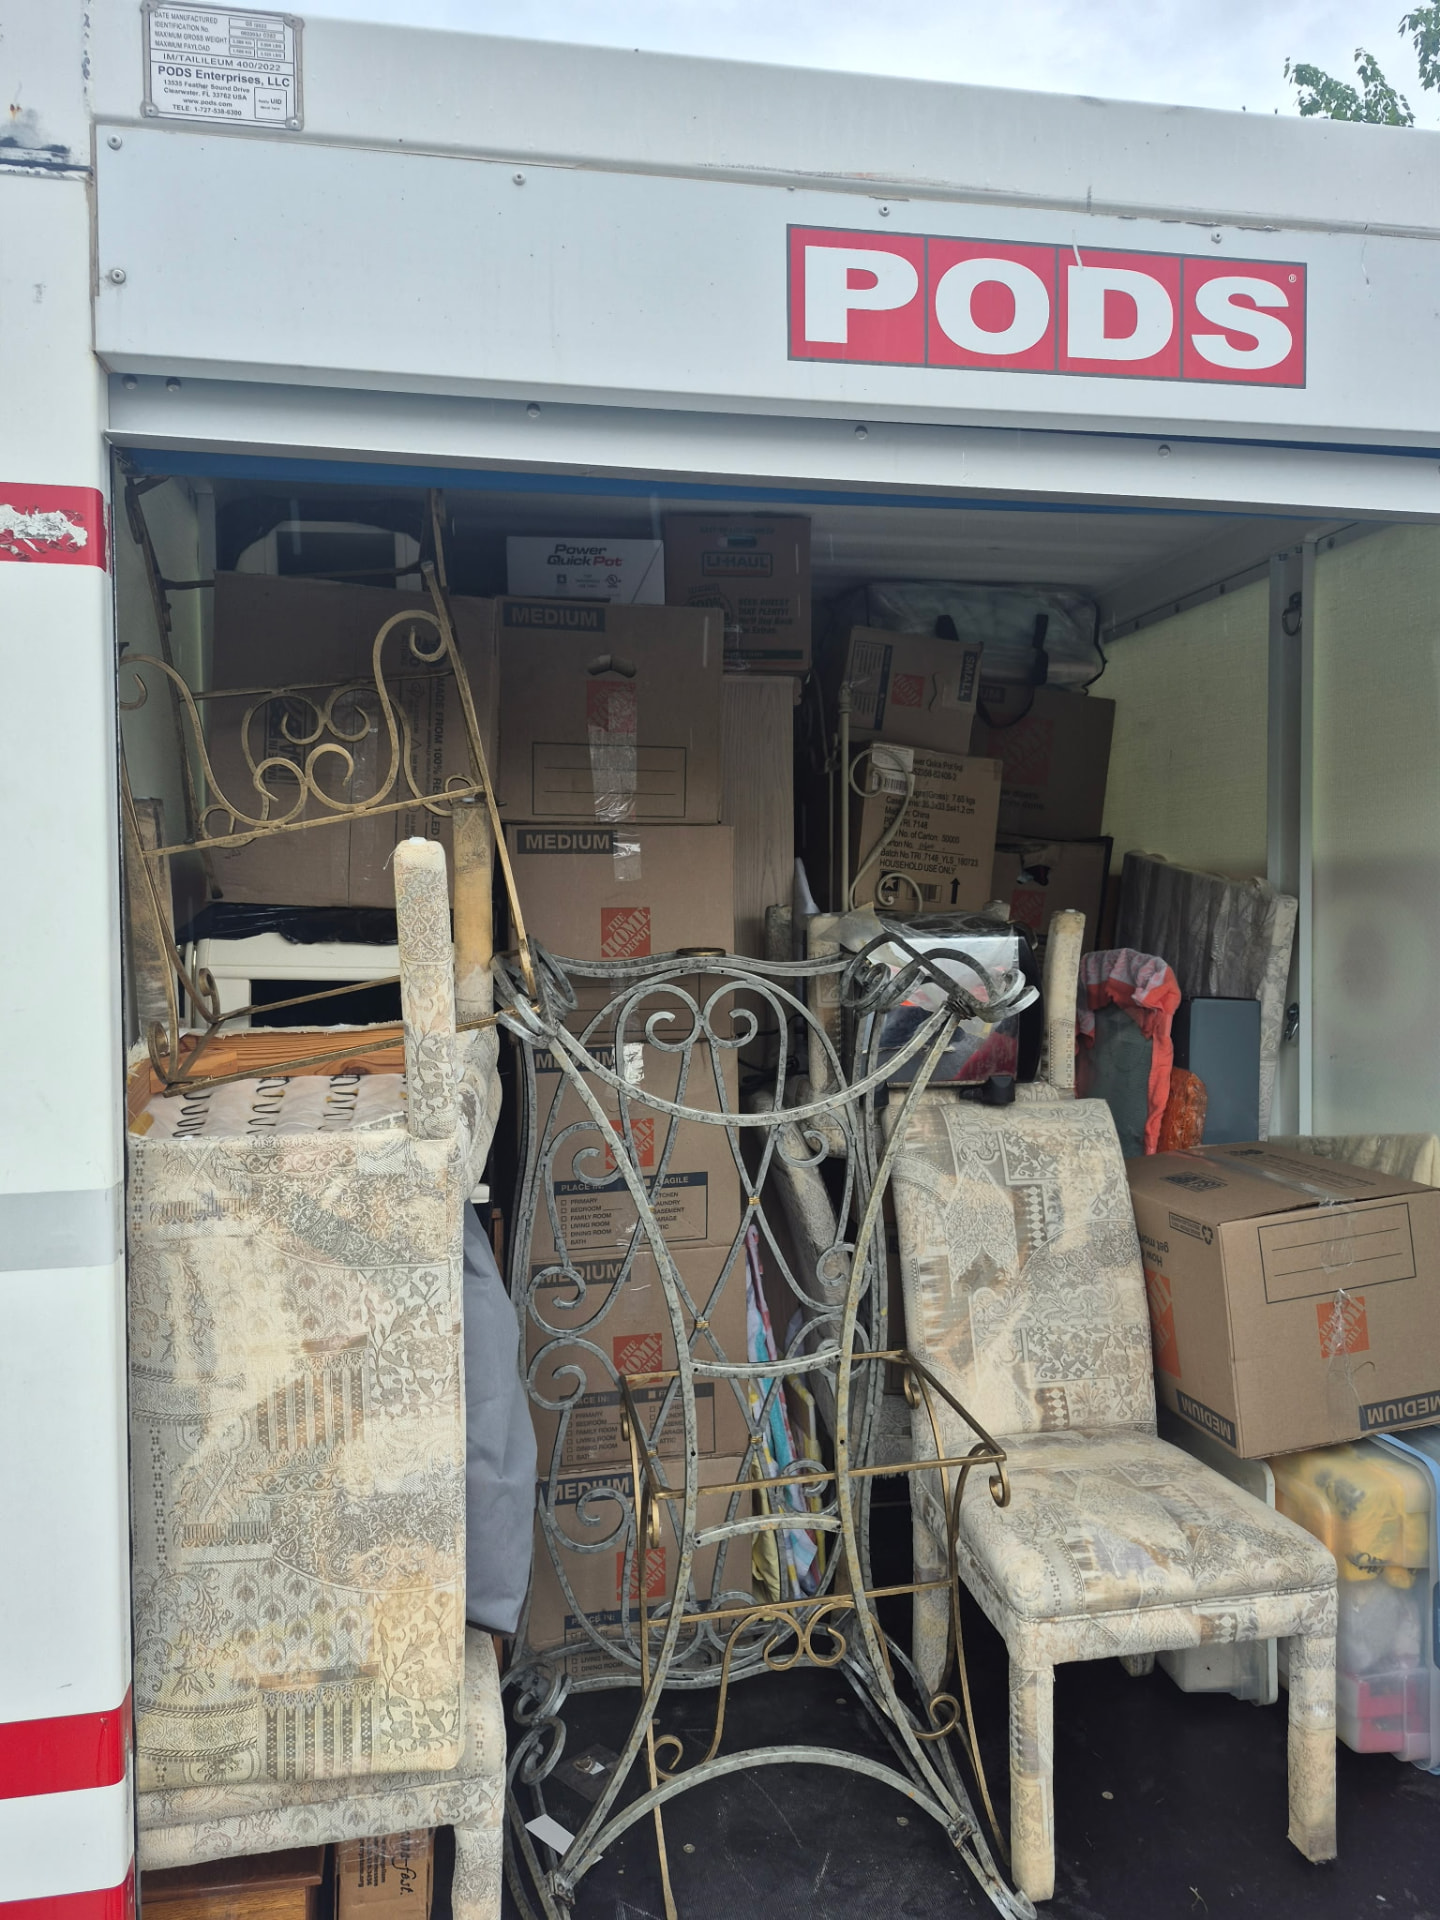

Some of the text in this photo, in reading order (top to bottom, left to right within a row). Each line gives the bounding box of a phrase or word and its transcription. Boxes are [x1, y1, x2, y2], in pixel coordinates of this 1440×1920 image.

[154, 11, 218, 24] DATE MANUFACTURED
[154, 21, 200, 31] IDENTIFICATION
[183, 33, 204, 42] GROSS
[204, 35, 227, 45] WEIGHT
[183, 43, 211, 52] PAYLOAD
[236, 61, 281, 71] 400/2022
[158, 65, 290, 88] PODS Enterprises, LLC
[164, 79, 250, 94] 13535 Feather Sound Drive
[182, 98, 233, 108] www.pods.com
[212, 92, 231, 100] 33762
[804, 245, 1293, 370] PODS
[554, 543, 607, 555] Power
[547, 555, 624, 567] Quick Pot
[706, 555, 769, 568] U-HAUL
[511, 607, 598, 627] MEDIUM
[959, 655, 976, 698] SMALL
[433, 711, 444, 744] FROM
[912, 811, 930, 820] China
[525, 834, 610, 851] MEDIUM
[880, 859, 957, 875] HOUSEHOLD USE ONLY
[606, 912, 627, 933] THE
[601, 908, 650, 957] HOME
[620, 924, 650, 957] DEPOT
[561, 1183, 590, 1191] PLACE
[570, 1197, 598, 1205] PRIMARY
[1179, 1396, 1233, 1438] MEDIUM
[1366, 1396, 1440, 1426] MEDIUM
